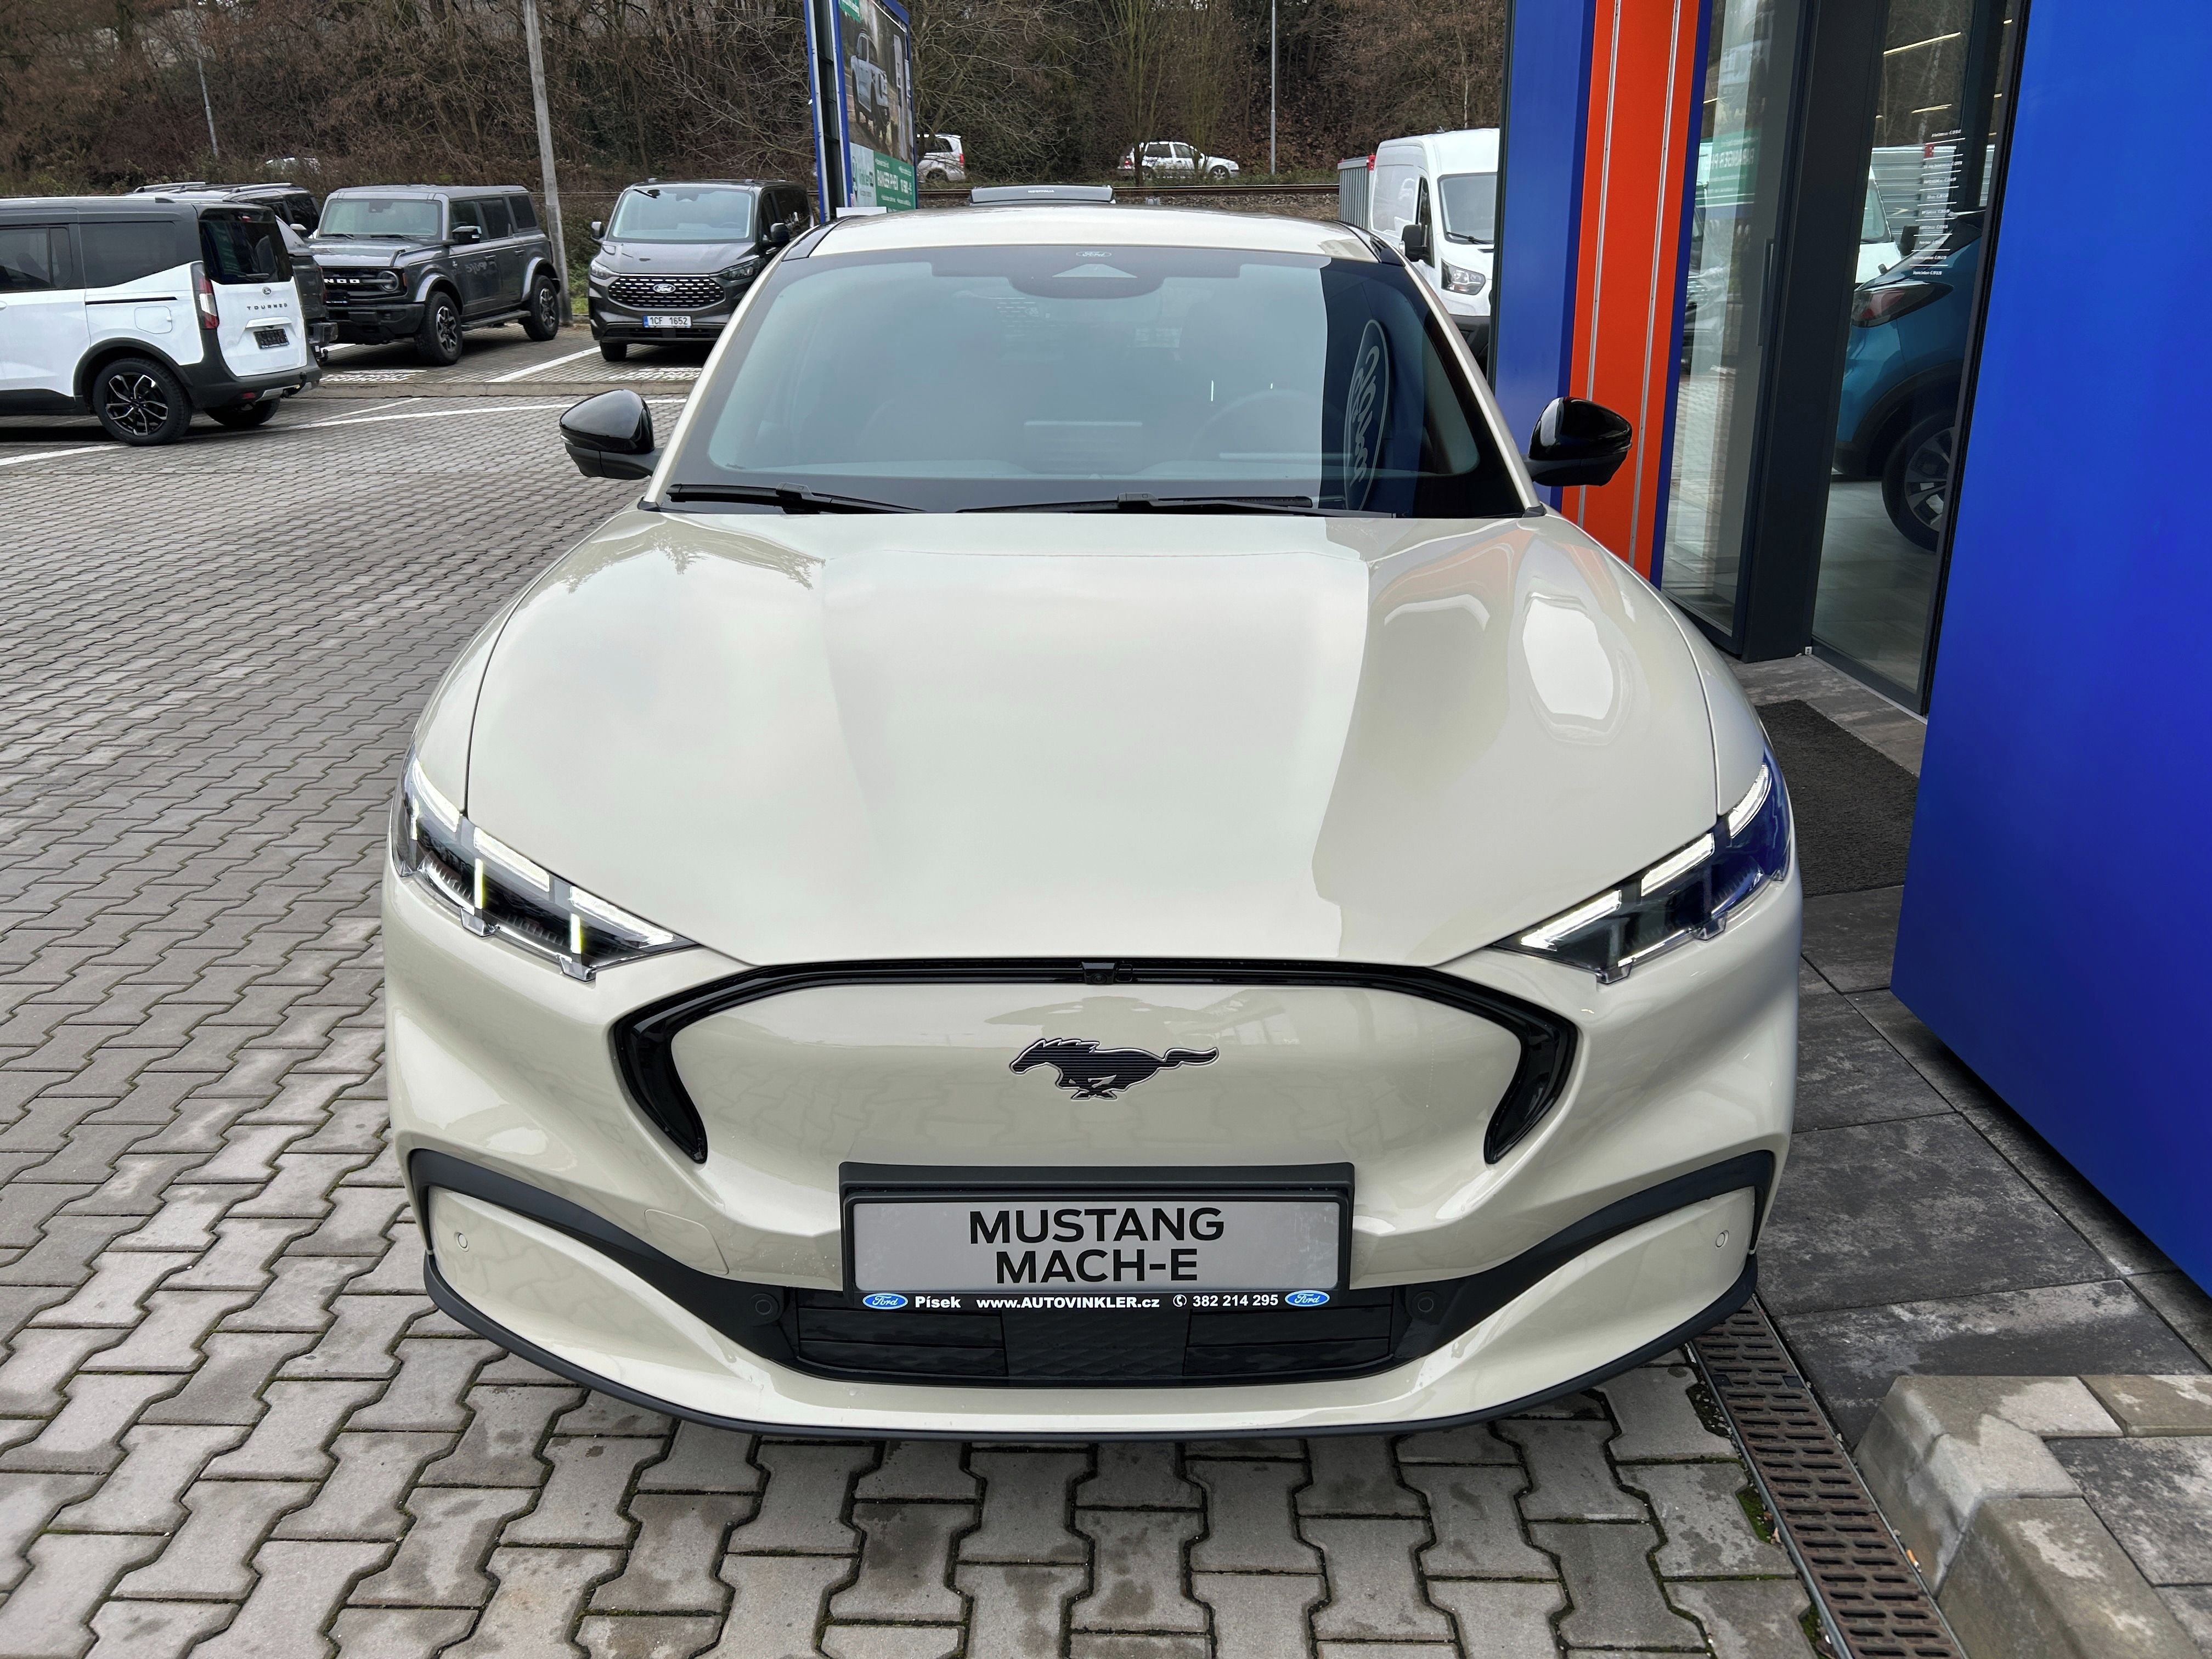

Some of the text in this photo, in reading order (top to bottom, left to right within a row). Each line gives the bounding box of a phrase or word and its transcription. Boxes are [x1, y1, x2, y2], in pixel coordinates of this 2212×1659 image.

[650, 317, 688, 325] 1CF 1652
[969, 1207, 1224, 1244] MUSTANG
[996, 1248, 1198, 1284] MACH-E
[915, 1296, 961, 1308] Písek
[977, 1296, 1160, 1308] www.AUTOVINKLER.cz
[1193, 1295, 1218, 1307] 382
[1222, 1295, 1249, 1306] 214
[1252, 1294, 1278, 1306] 295
